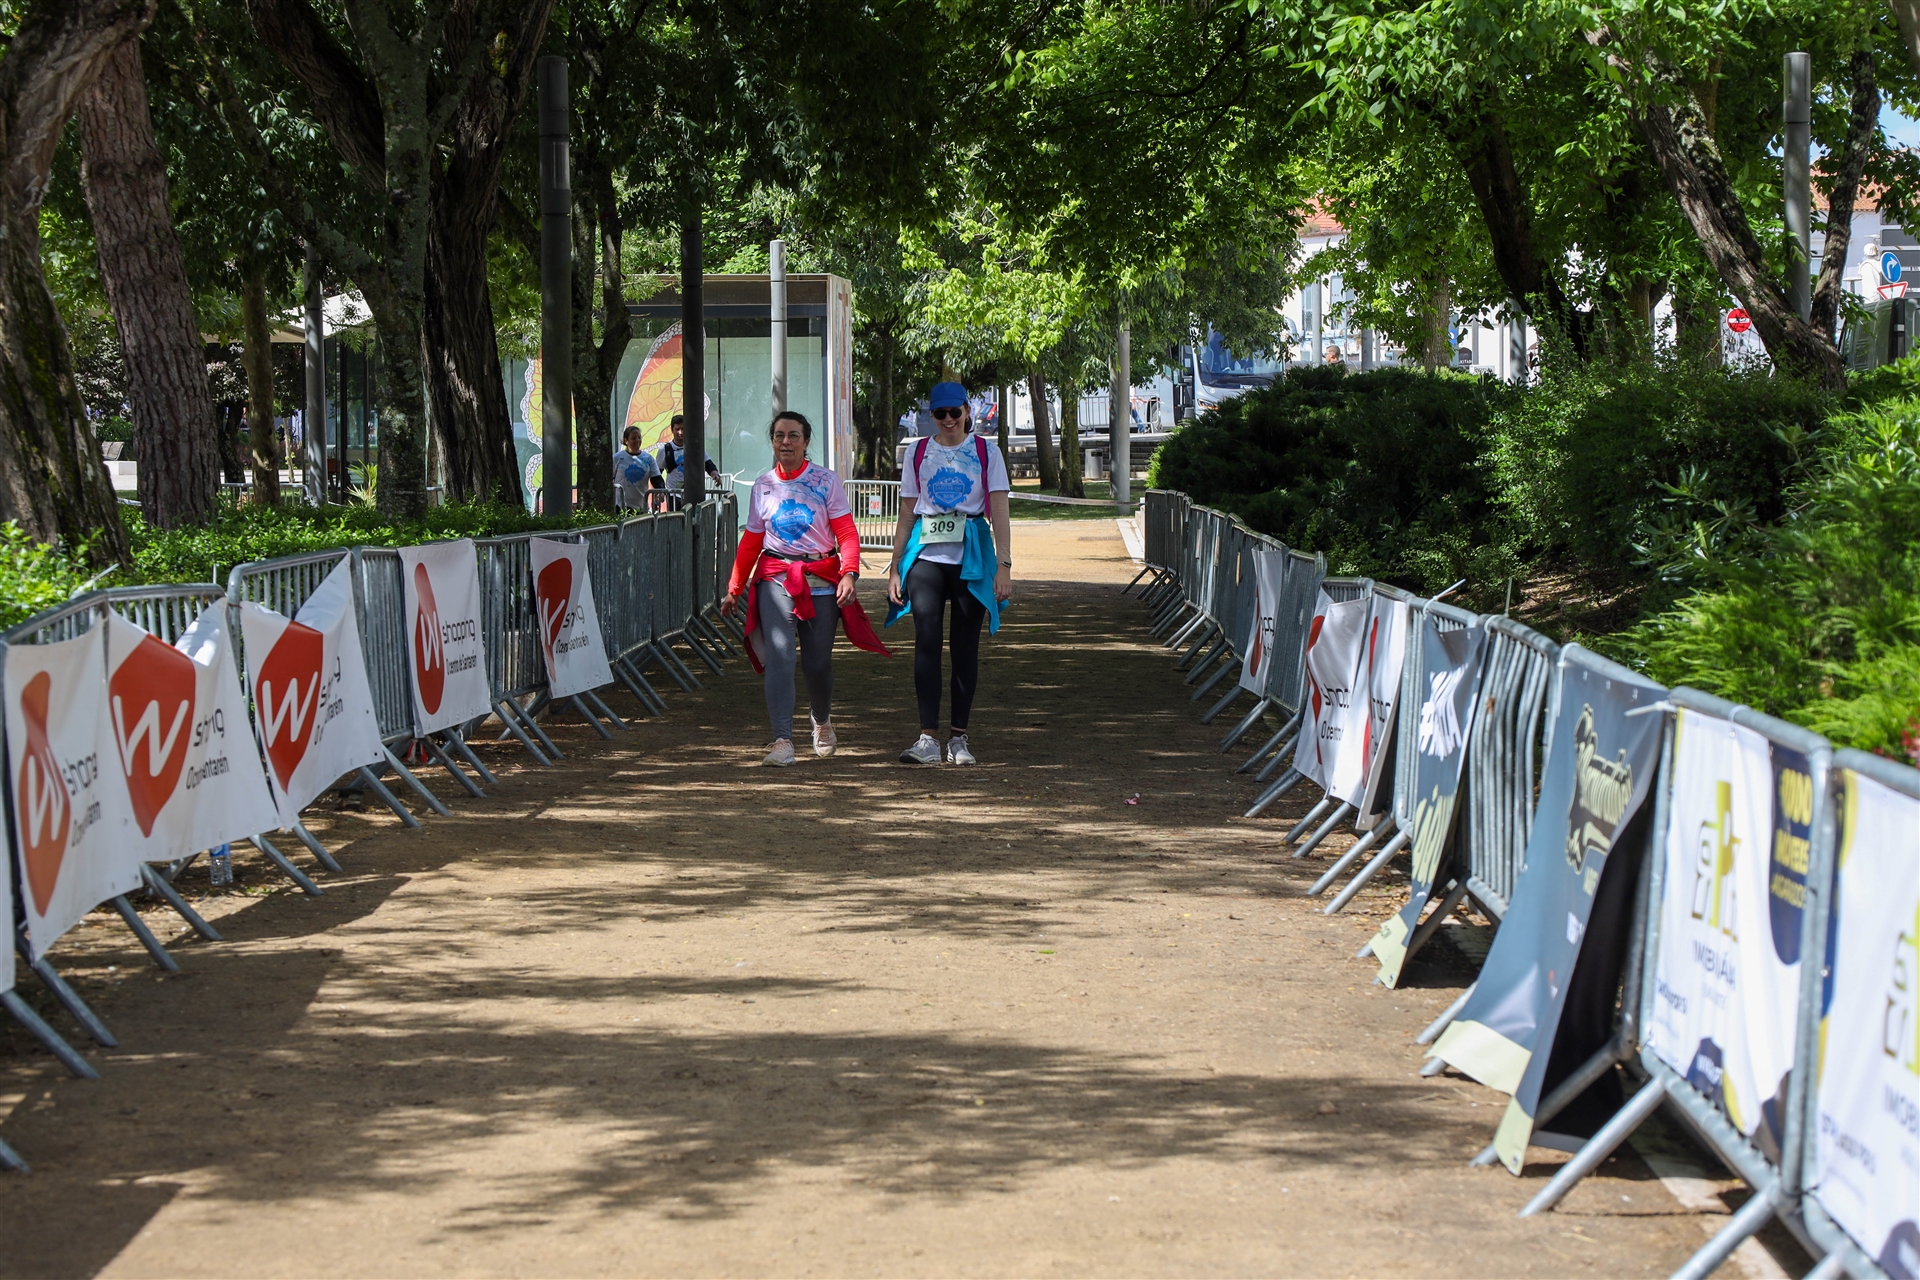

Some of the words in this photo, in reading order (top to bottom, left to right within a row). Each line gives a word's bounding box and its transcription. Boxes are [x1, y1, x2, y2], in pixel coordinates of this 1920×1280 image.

[930, 520, 955, 534] 309
[112, 695, 189, 777] W
[262, 671, 319, 748] W
